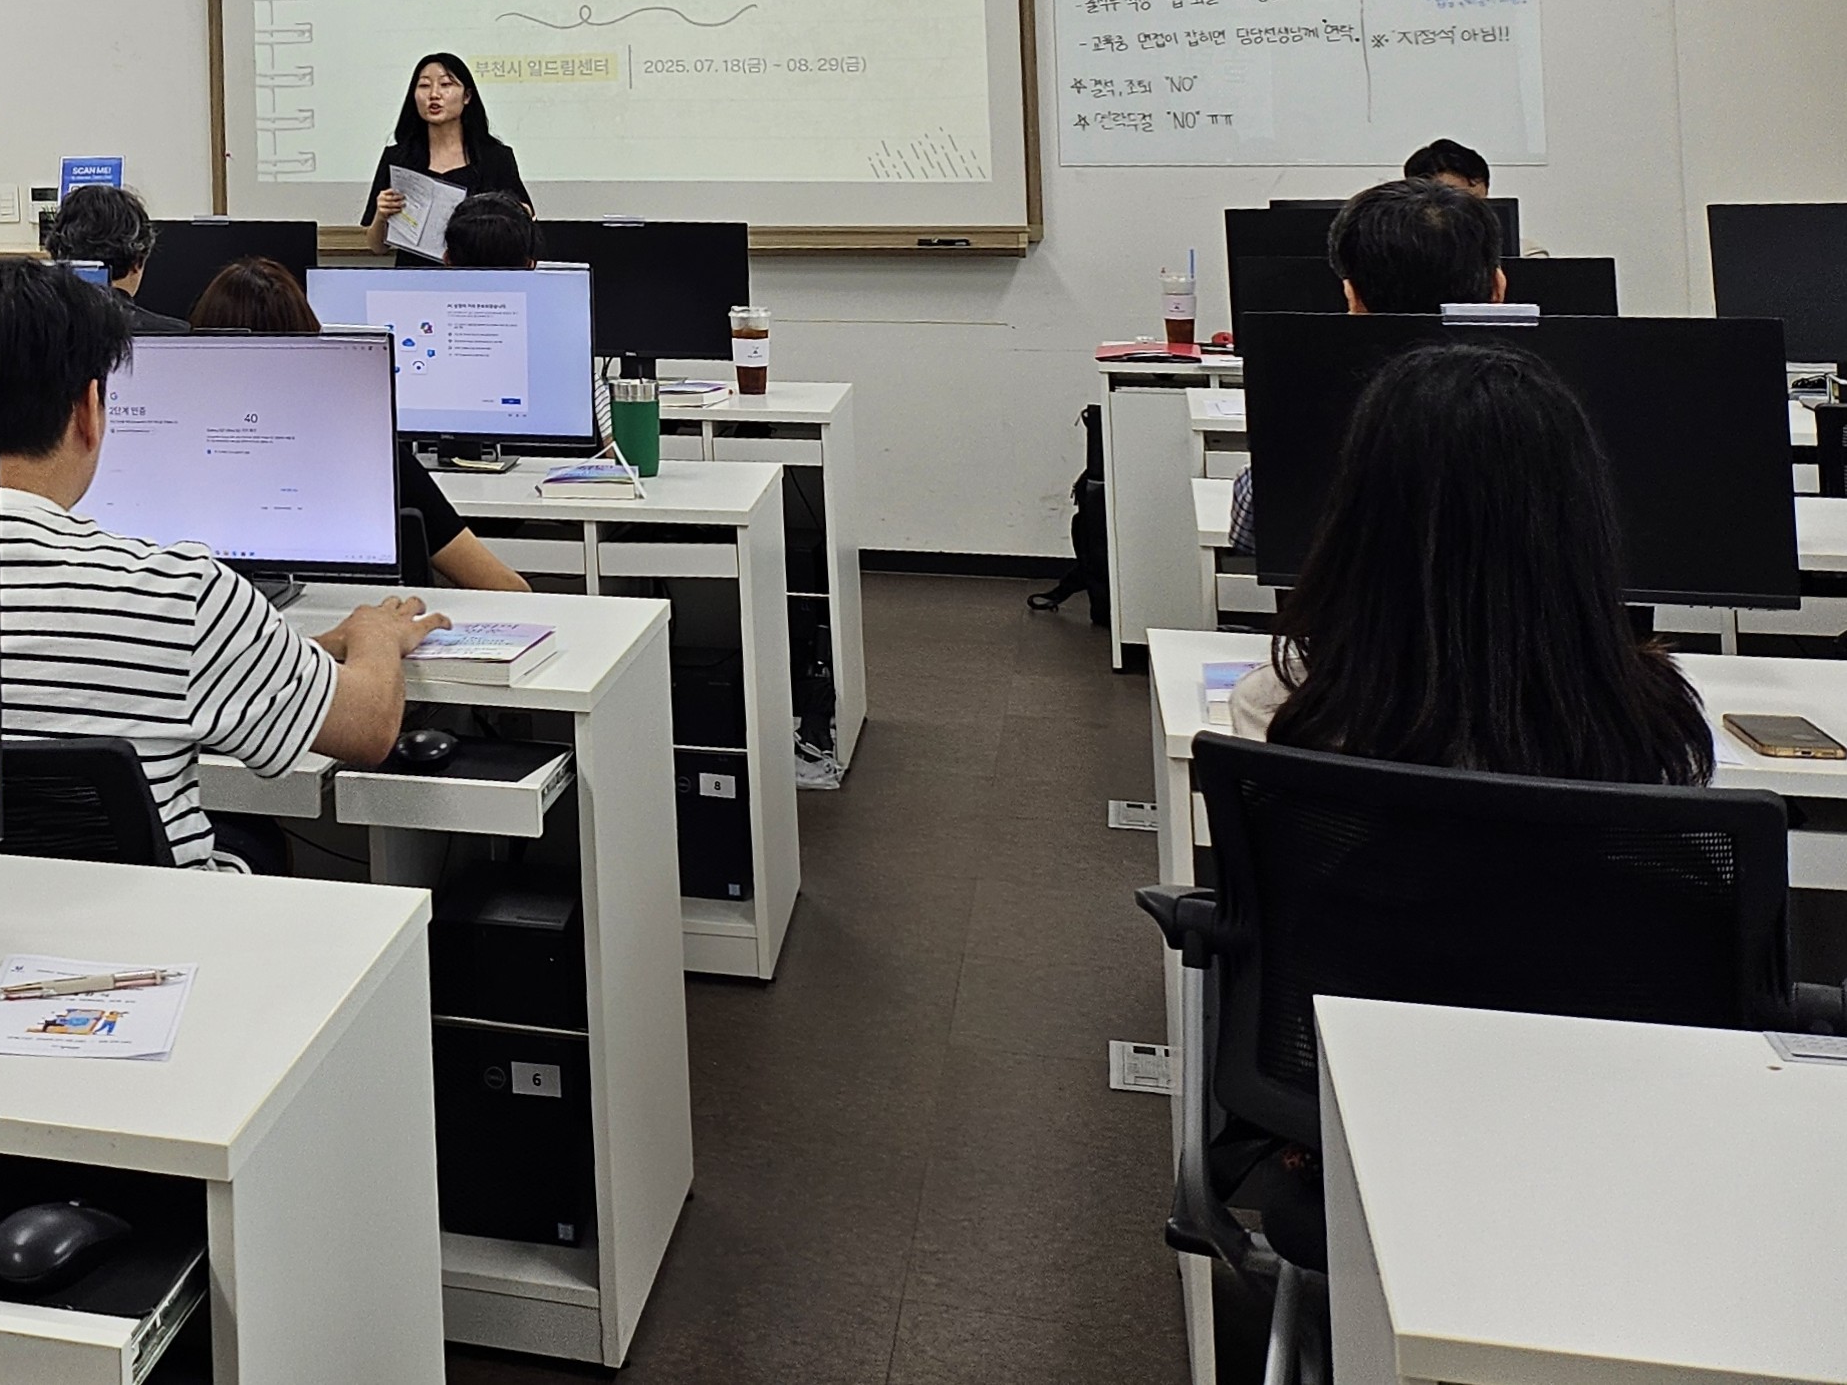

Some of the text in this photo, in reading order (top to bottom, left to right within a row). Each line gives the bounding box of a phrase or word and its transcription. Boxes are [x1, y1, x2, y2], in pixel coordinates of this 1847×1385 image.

[1137, 31, 1179, 50] 면접이
[1184, 28, 1226, 47] 잡히면
[475, 58, 609, 78] 부천시 일드림센터
[72, 166, 112, 175] SCAN ME!
[244, 413, 258, 424] 40
[714, 780, 721, 791] 8
[532, 1072, 542, 1087] 6
